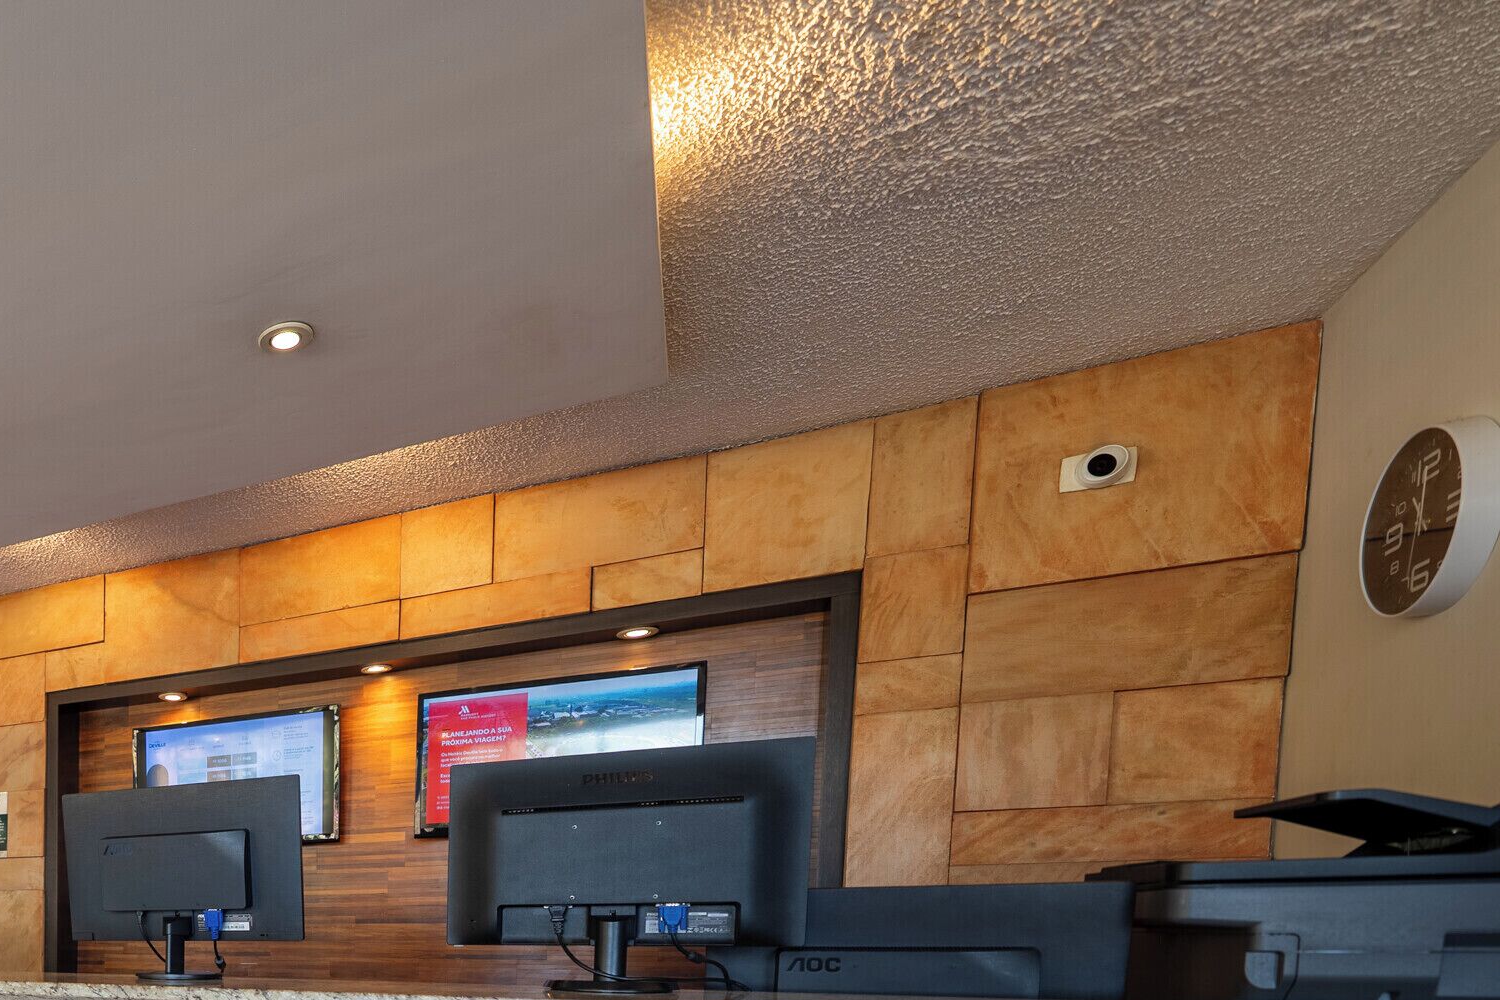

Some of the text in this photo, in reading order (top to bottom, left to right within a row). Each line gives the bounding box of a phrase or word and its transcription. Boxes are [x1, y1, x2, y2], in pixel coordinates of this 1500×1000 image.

[1385, 522, 1403, 556] 9
[1390, 560, 1400, 576] 8
[1409, 558, 1430, 592] 6
[441, 730, 489, 739] PLANEJANDO
[441, 735, 506, 746] PRÓXIMA VIAGEM?
[581, 768, 654, 786] PHILIPS
[786, 957, 841, 973] AOC
